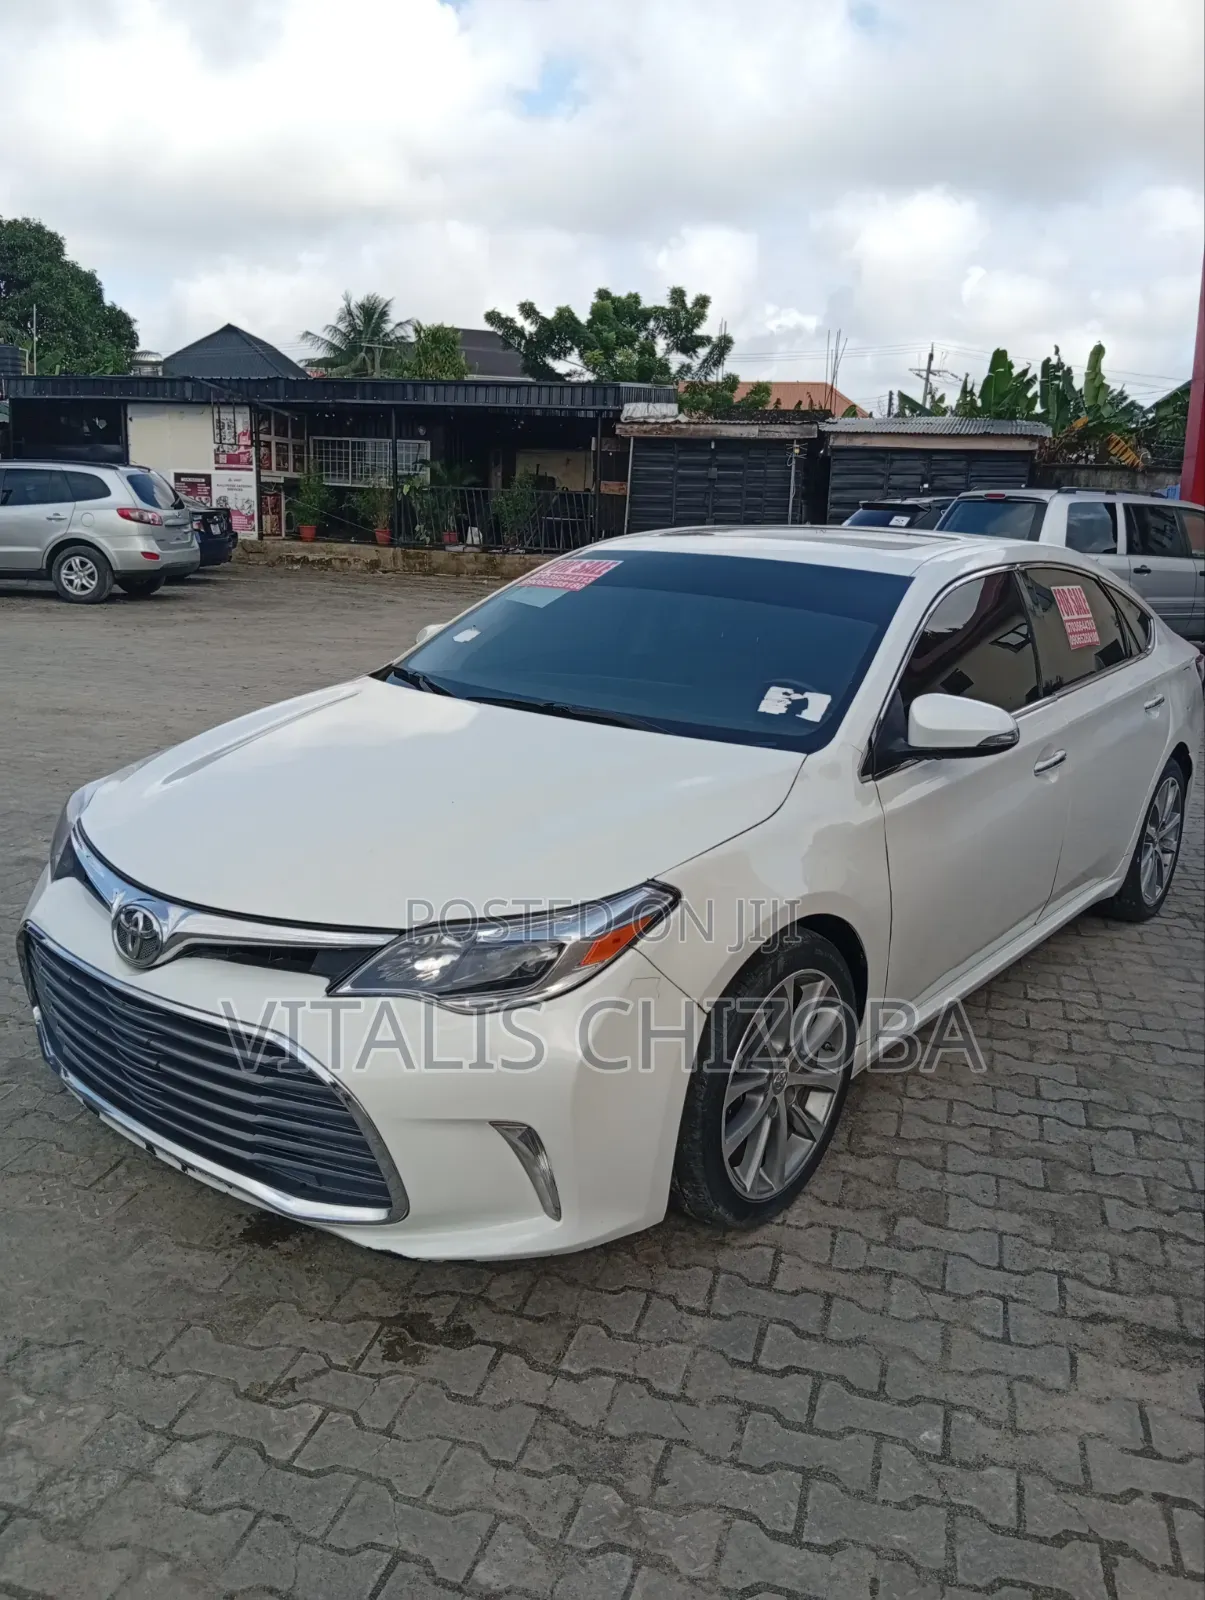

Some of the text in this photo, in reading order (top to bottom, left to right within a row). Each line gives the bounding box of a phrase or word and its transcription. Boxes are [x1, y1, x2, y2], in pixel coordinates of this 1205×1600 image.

[570, 560, 622, 575] SALE
[1053, 587, 1090, 617] FOR SALE
